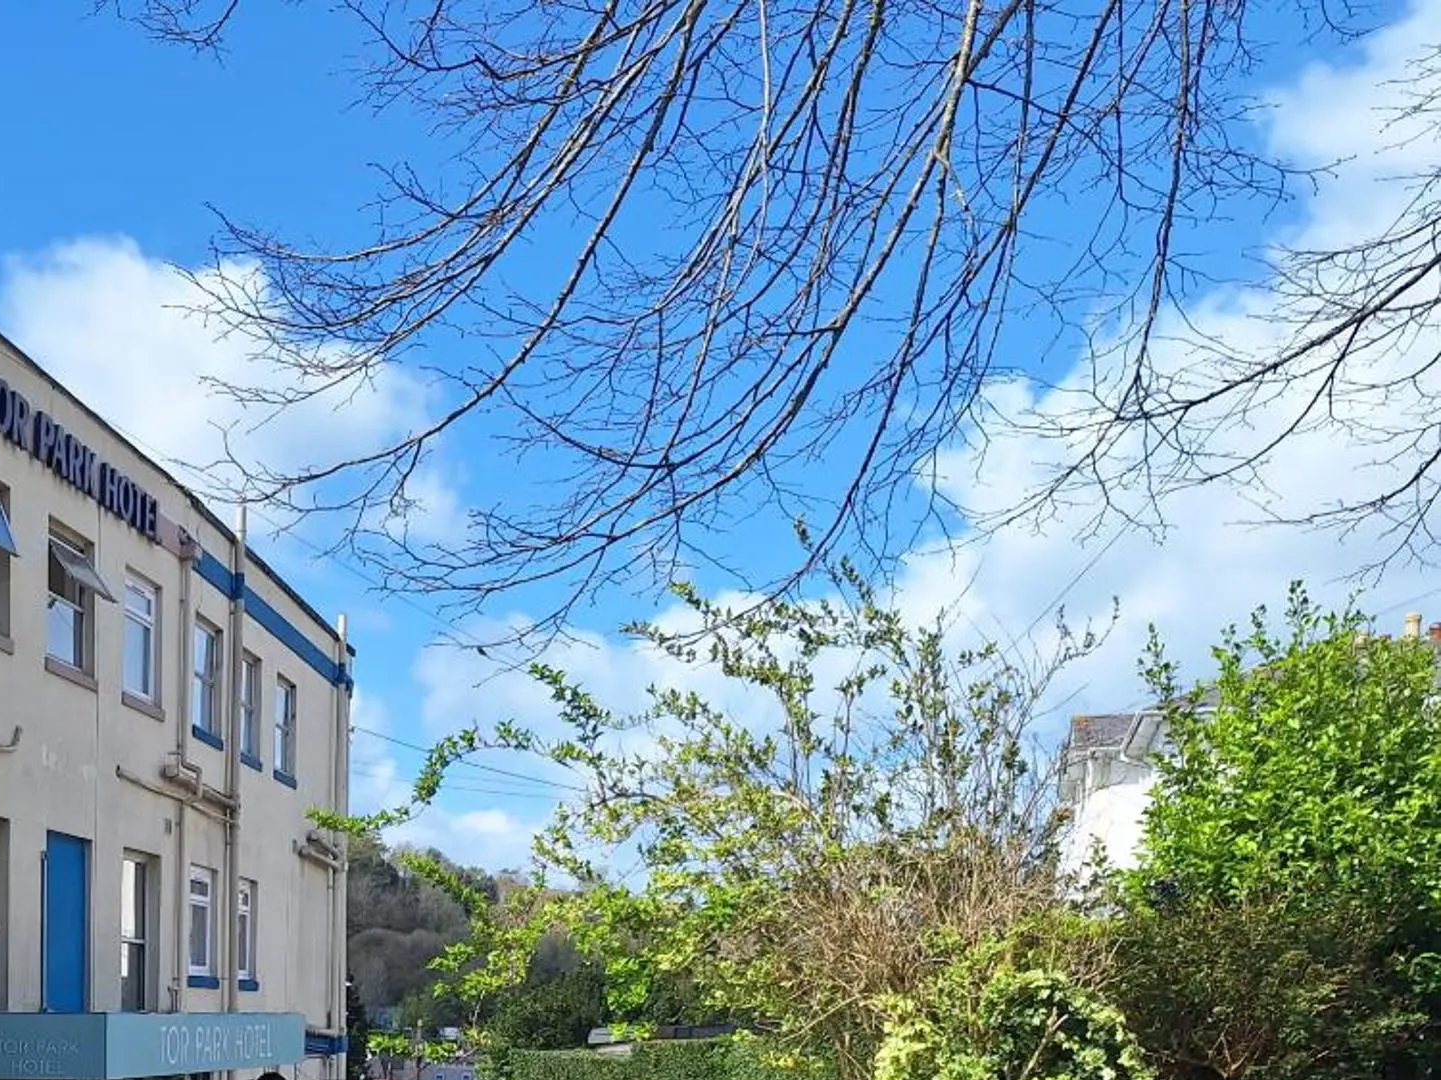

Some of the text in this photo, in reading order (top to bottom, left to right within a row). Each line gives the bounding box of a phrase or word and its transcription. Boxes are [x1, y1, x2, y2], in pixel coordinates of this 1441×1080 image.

[36, 1039, 79, 1054] PARK
[159, 1022, 272, 1064] TOR PARK HOTEL
[9, 1058, 65, 1075] HOTEL
